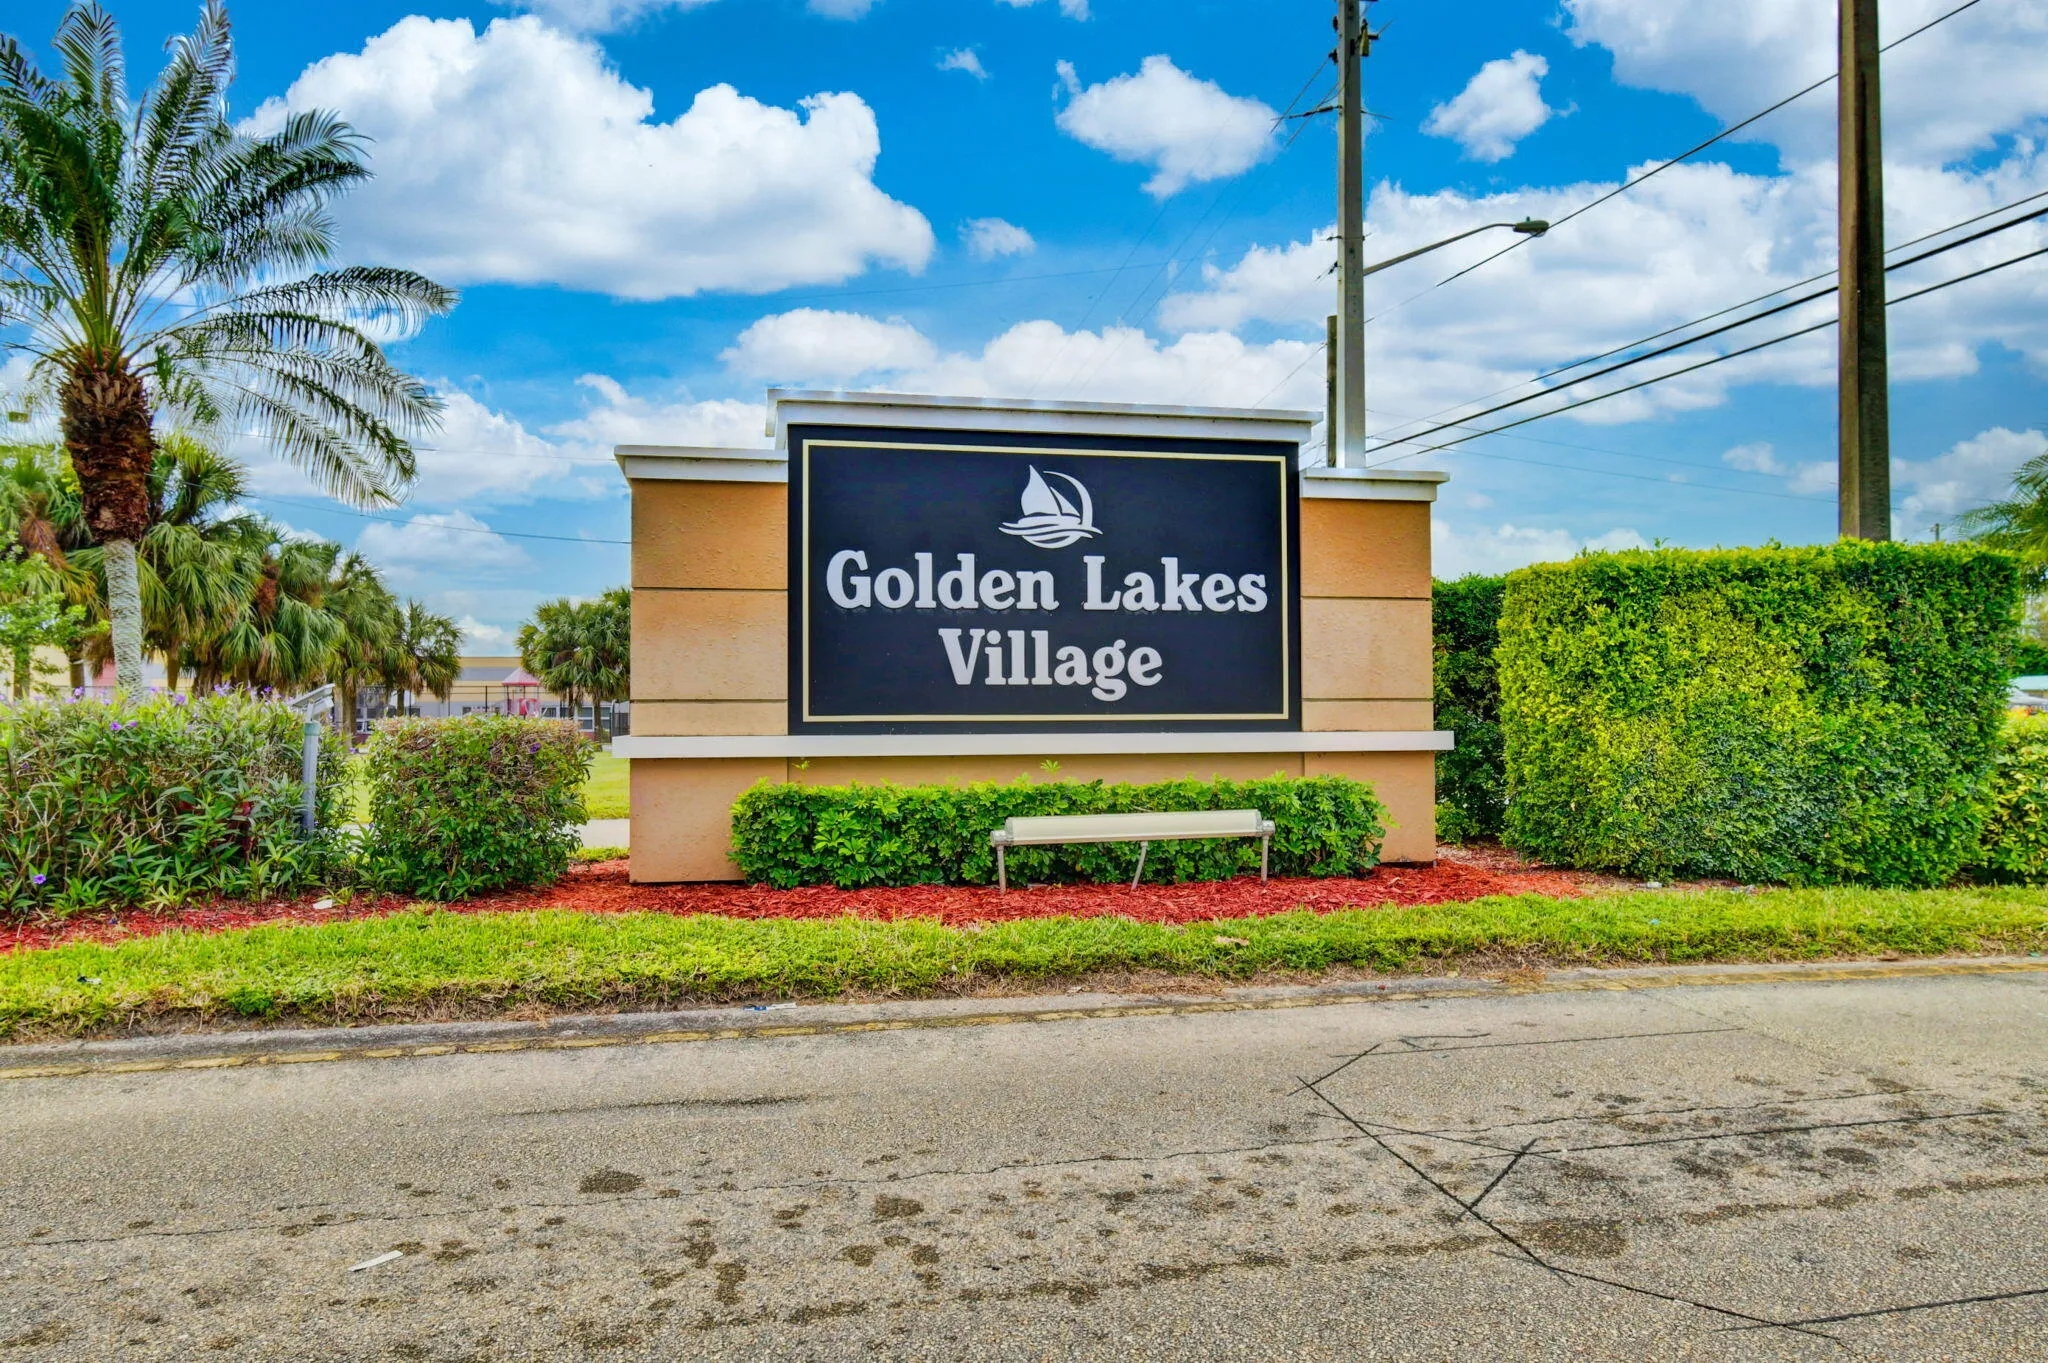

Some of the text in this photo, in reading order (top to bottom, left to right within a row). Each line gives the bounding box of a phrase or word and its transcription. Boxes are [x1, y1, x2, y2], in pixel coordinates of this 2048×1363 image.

[825, 549, 1269, 613] Golden Lakes
[937, 627, 1163, 703] Village
